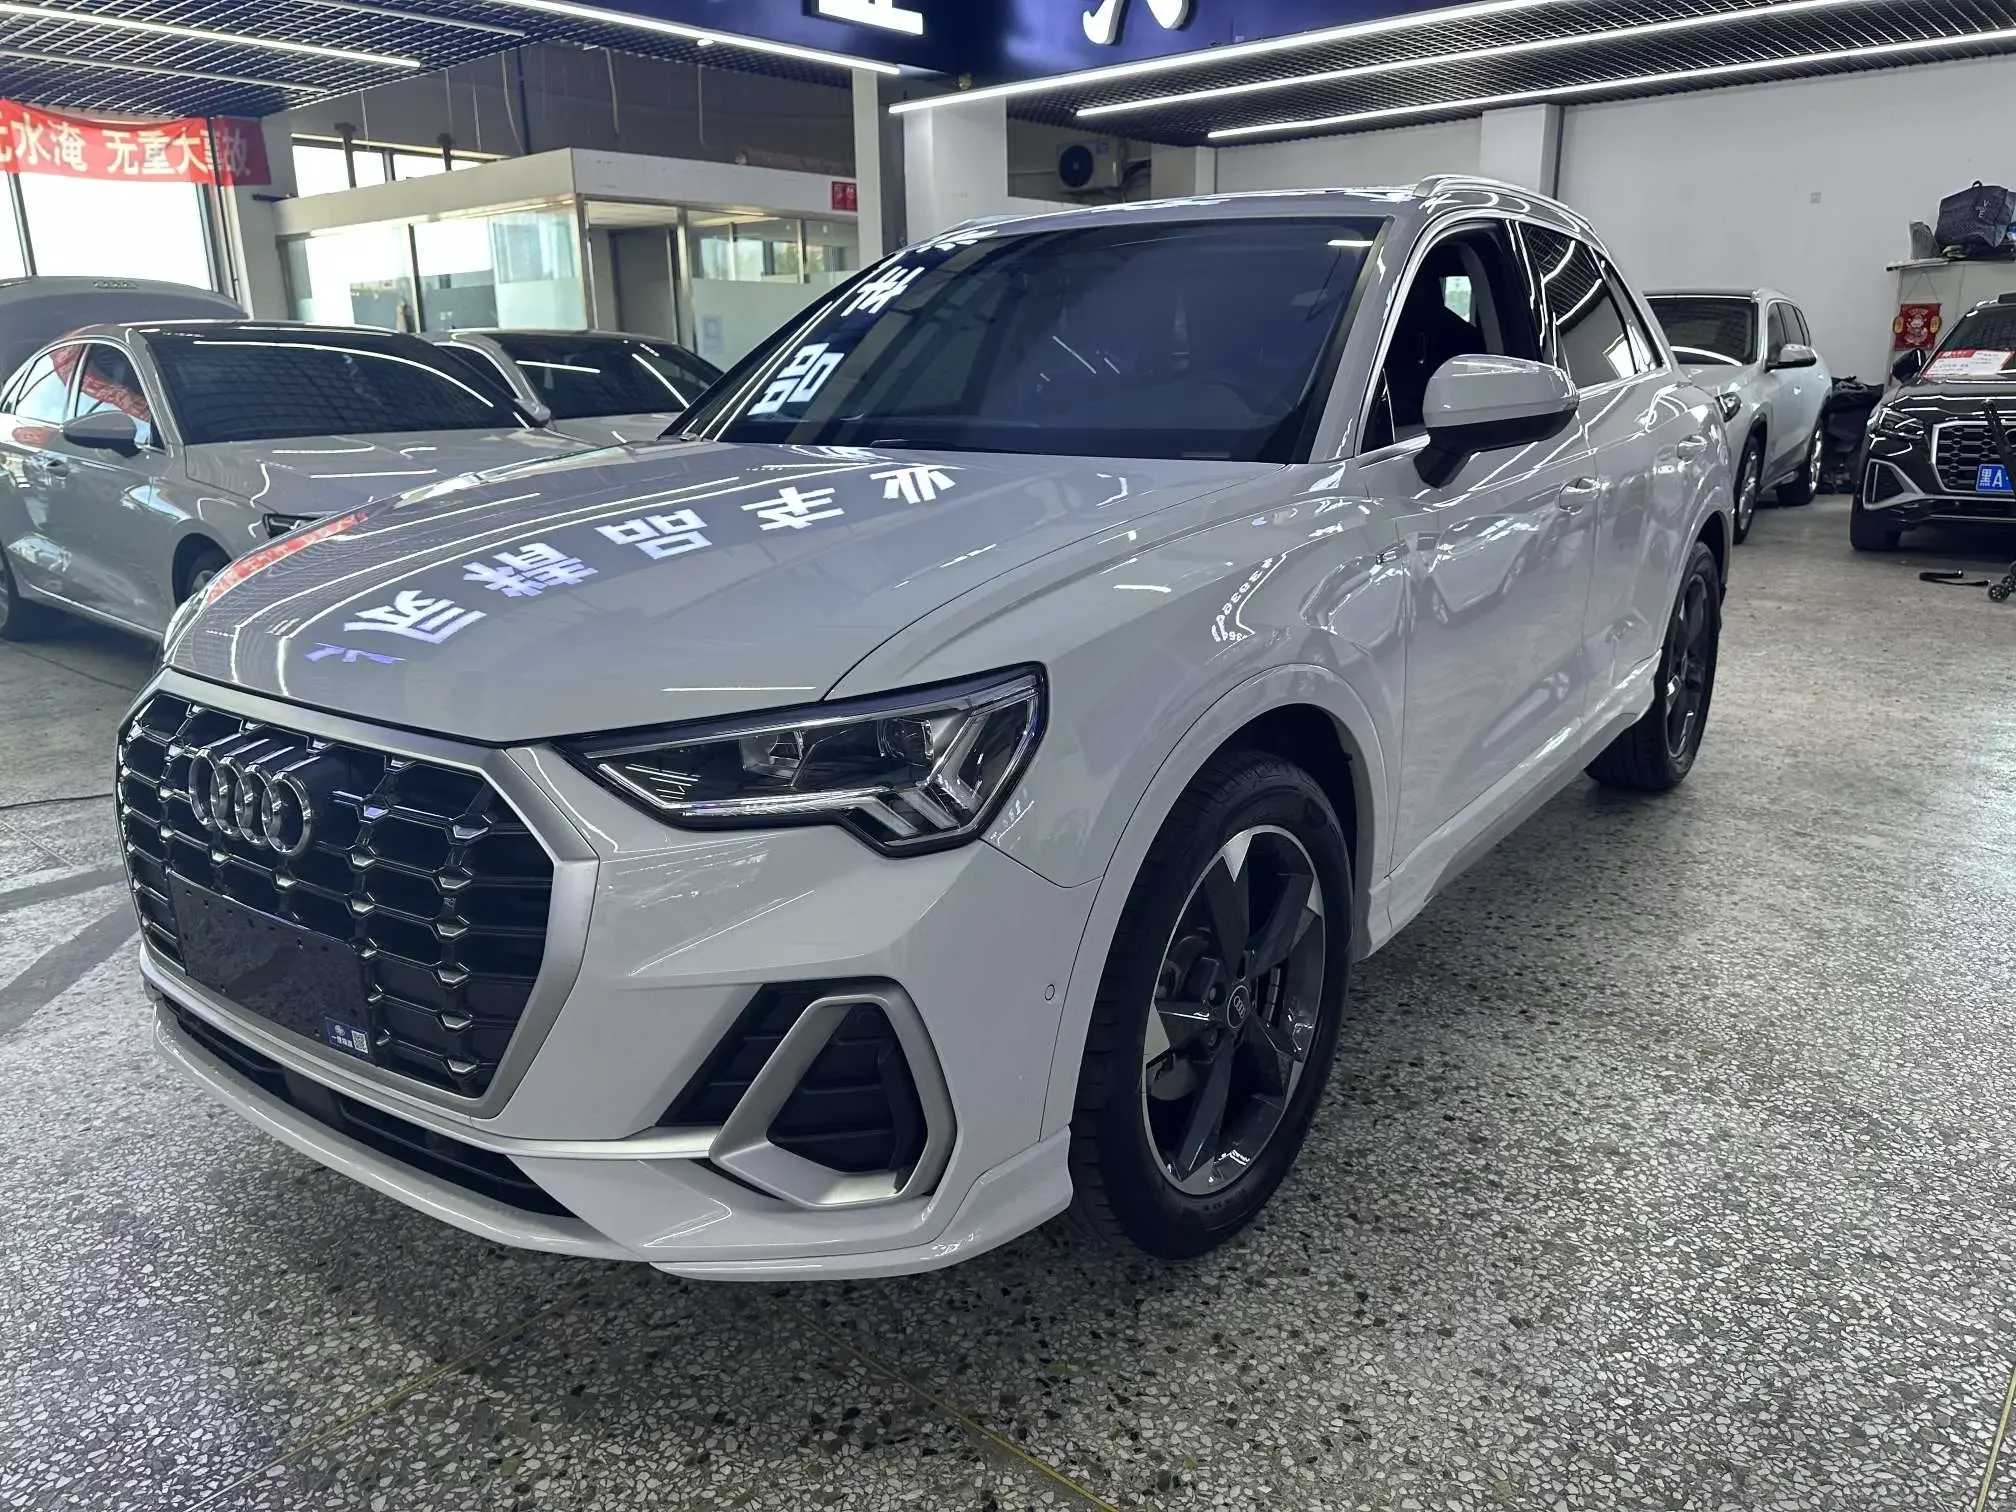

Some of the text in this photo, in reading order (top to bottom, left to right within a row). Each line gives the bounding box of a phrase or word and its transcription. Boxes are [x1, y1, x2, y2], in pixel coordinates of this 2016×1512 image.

[102, 128, 251, 177] 无重大事故
